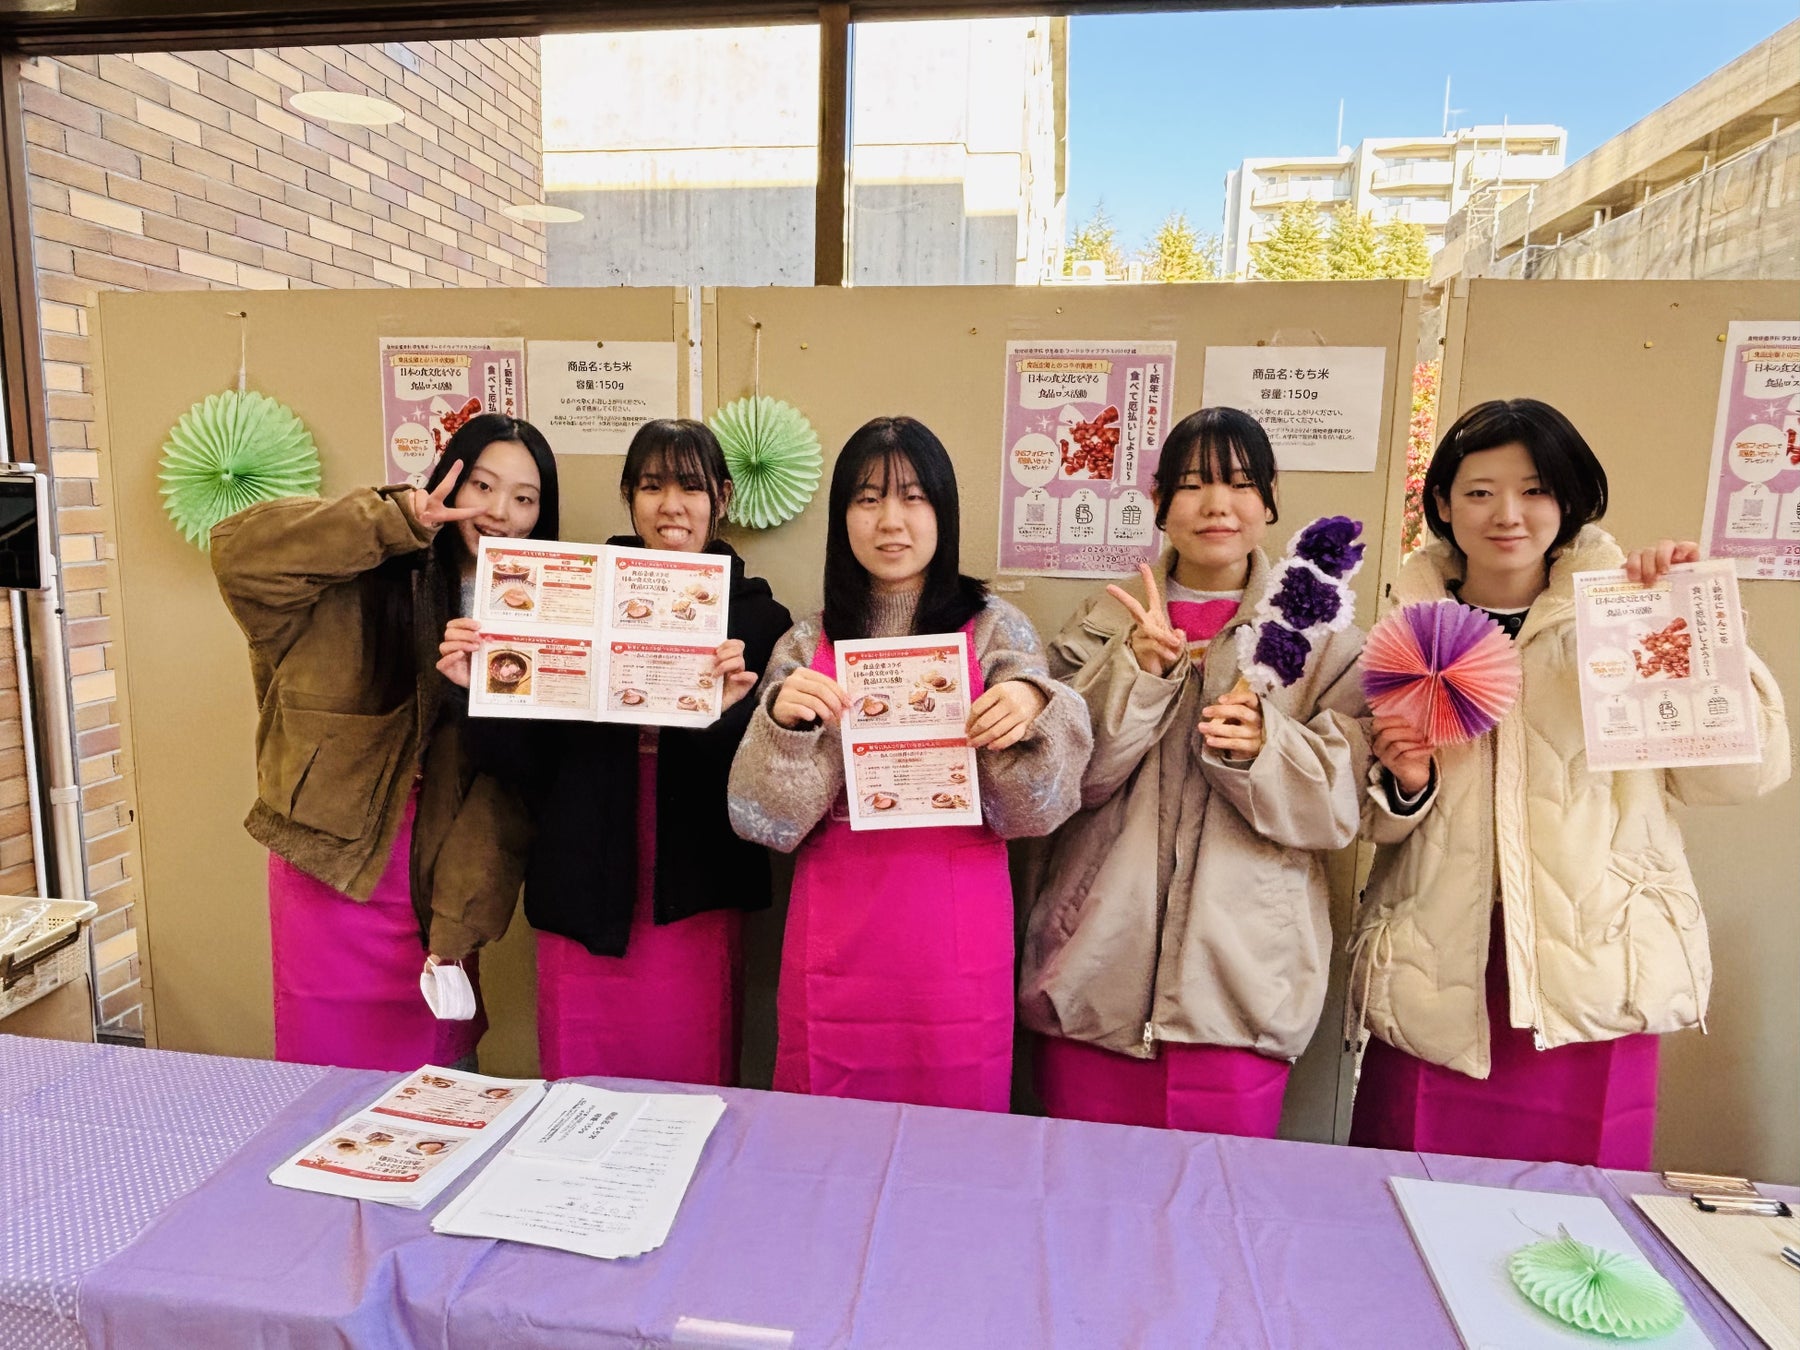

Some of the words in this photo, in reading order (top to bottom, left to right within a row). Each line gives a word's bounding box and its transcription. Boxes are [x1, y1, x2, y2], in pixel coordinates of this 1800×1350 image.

[400, 367, 462, 378] 日本の食文化を守る
[567, 361, 632, 373] 商品名：もち米
[1755, 363, 1800, 374] 日本の食文
[1027, 373, 1099, 384] 日本の食文化を守る
[1252, 368, 1329, 381] 商品名：もち米
[410, 381, 453, 392] 食品ロス活動
[576, 380, 625, 391] 容量：150g
[1038, 388, 1088, 399] 食品ロス活動
[1261, 388, 1319, 401] 容量：150g
[863, 676, 903, 686] 食品ロス活動
